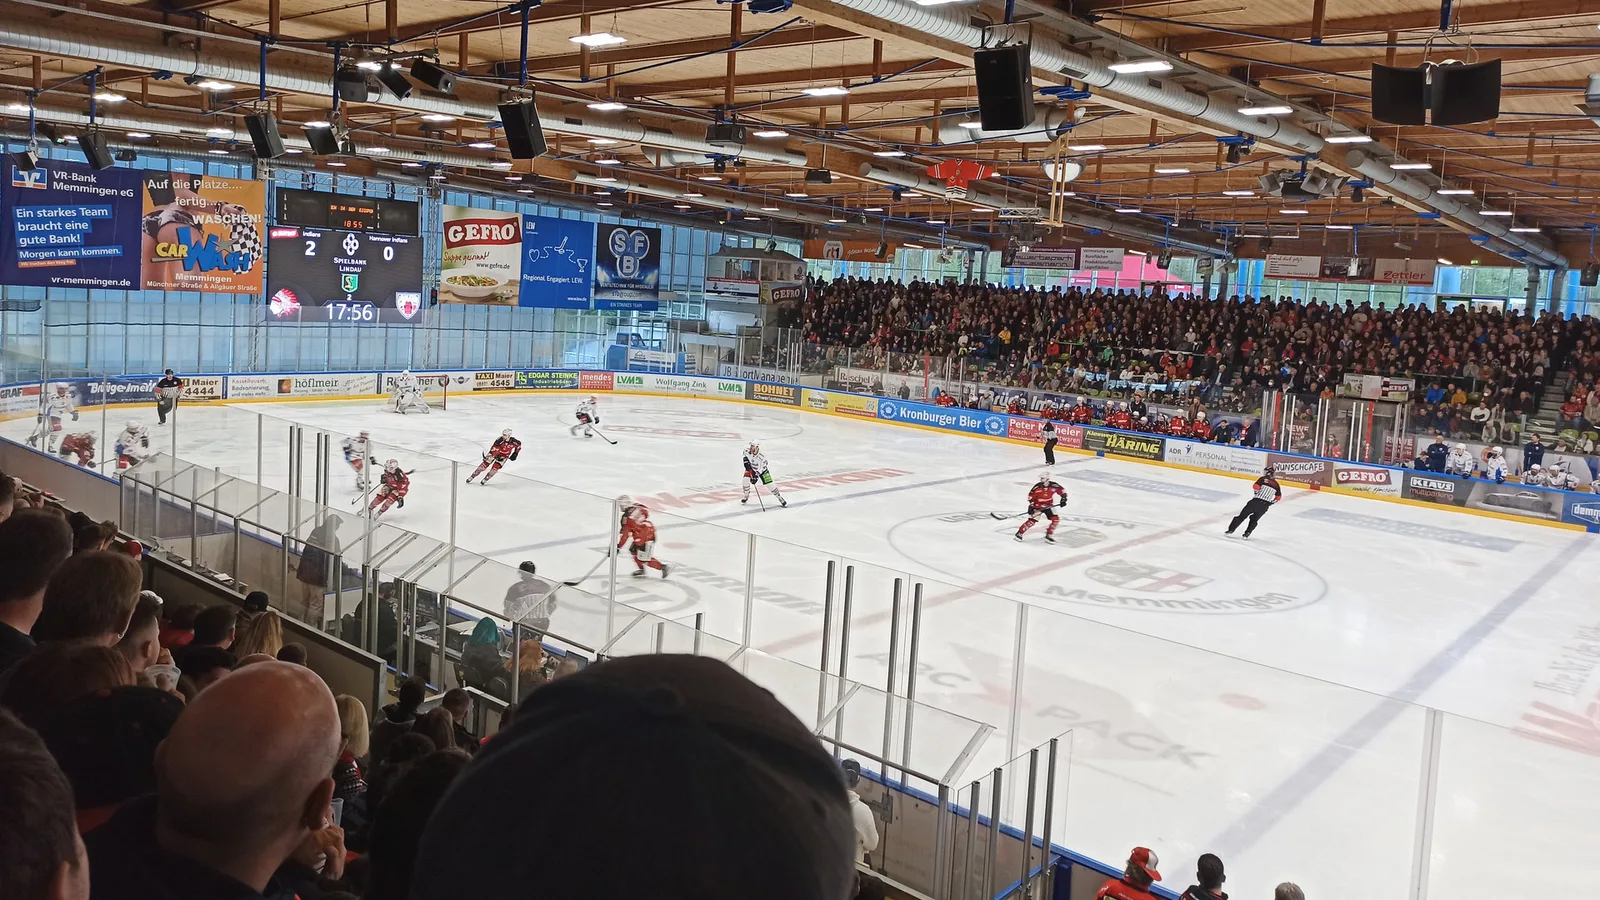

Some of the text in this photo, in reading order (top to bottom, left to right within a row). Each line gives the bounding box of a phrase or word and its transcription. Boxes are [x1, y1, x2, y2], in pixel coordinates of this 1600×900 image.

[53, 170, 97, 183] VR-Bank
[53, 181, 134, 198] Memmingen eG
[147, 179, 169, 189] Auf
[172, 179, 190, 189] die
[16, 206, 109, 218] Ein starkes Team
[192, 215, 262, 225] WASCHEN!
[526, 221, 536, 230] LEW
[17, 221, 89, 232] braucht eine
[448, 224, 515, 243] GEFRO
[19, 233, 81, 248] gute Bank!
[614, 234, 645, 254] S F
[20, 247, 121, 260] Morgen kann kommen.
[156, 226, 250, 272] CAR WASH
[305, 240, 316, 256] 2
[383, 246, 394, 261] 0
[443, 251, 462, 264] Suppe
[476, 262, 511, 271] www.gefro.de
[622, 255, 635, 273] B
[175, 273, 233, 283] Memmingen
[1383, 270, 1426, 280] Zettler
[51, 276, 131, 287] vr-memmingen.de
[773, 288, 800, 300] GEFRO
[326, 303, 373, 321] 17:56
[295, 378, 338, 389] höflmeir
[490, 379, 510, 387] 4545
[617, 376, 636, 385] LVM
[656, 378, 707, 389] Wolfgang Zink
[184, 387, 214, 396] 4444
[718, 382, 735, 392] LVM
[754, 383, 795, 397] BOHNET
[900, 406, 982, 429] Kronburger Bier
[1009, 418, 1036, 430] Peter
[1009, 428, 1031, 436] Fleisch-
[1105, 436, 1160, 454] HÄRING
[1195, 451, 1228, 462] PERSONAL
[1337, 471, 1387, 484] GEFRO
[1413, 478, 1453, 491] KLAUS
[1410, 489, 1453, 502] multiparking
[1046, 583, 1299, 611] Memmingen
